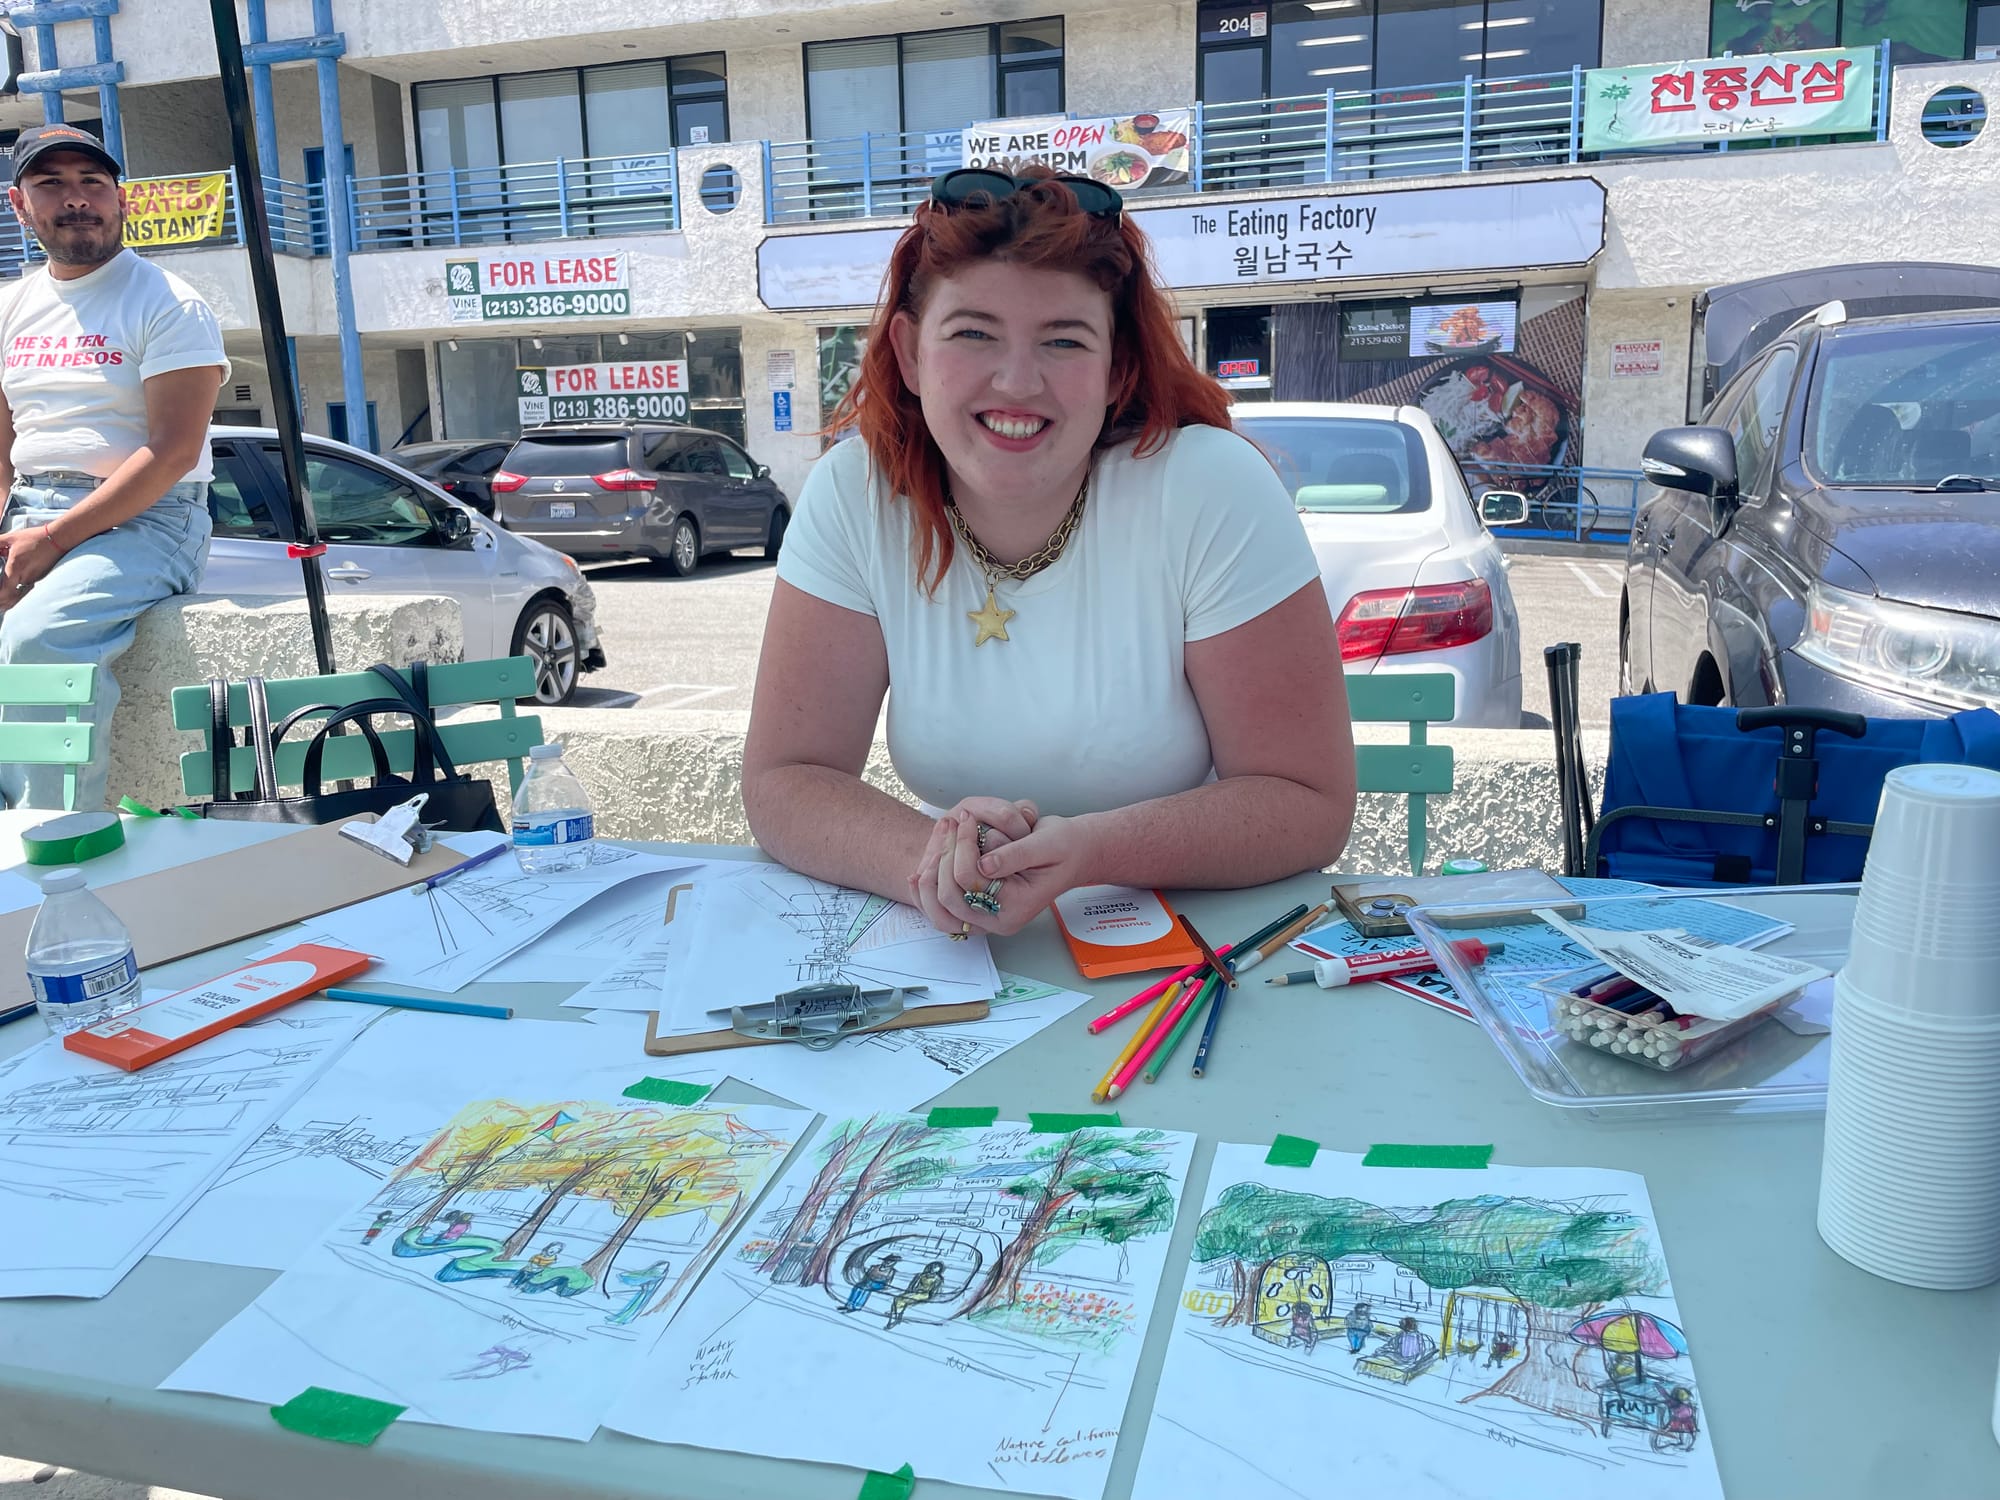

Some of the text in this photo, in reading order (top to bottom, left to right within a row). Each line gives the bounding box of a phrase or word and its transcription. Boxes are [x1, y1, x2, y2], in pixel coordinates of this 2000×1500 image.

[1219, 17, 1250, 33] 204
[1651, 59, 1852, 114] 천종산삼
[968, 125, 1105, 154] WE ARE OPEN
[129, 180, 201, 199] ANCE
[126, 192, 219, 215] RATION
[1192, 204, 1377, 241] The Eating Factory
[1233, 241, 1353, 277] 월남국수
[490, 257, 618, 287] FOR LEASE
[453, 298, 477, 308] VINE
[486, 300, 524, 316] (213)
[526, 293, 627, 316] 386-9000
[14, 335, 109, 350] HE'S A TEN
[6, 351, 123, 368] BUT IN PESOS
[1220, 361, 1257, 375] OPEN
[555, 365, 680, 392] FOR LEASE
[524, 401, 544, 410] VINE
[553, 401, 589, 418] (213)
[594, 395, 686, 418] 386-9000
[1083, 901, 1134, 910] PENCILS
[1083, 906, 1140, 916] COLORED
[201, 991, 241, 1005] COLORED
